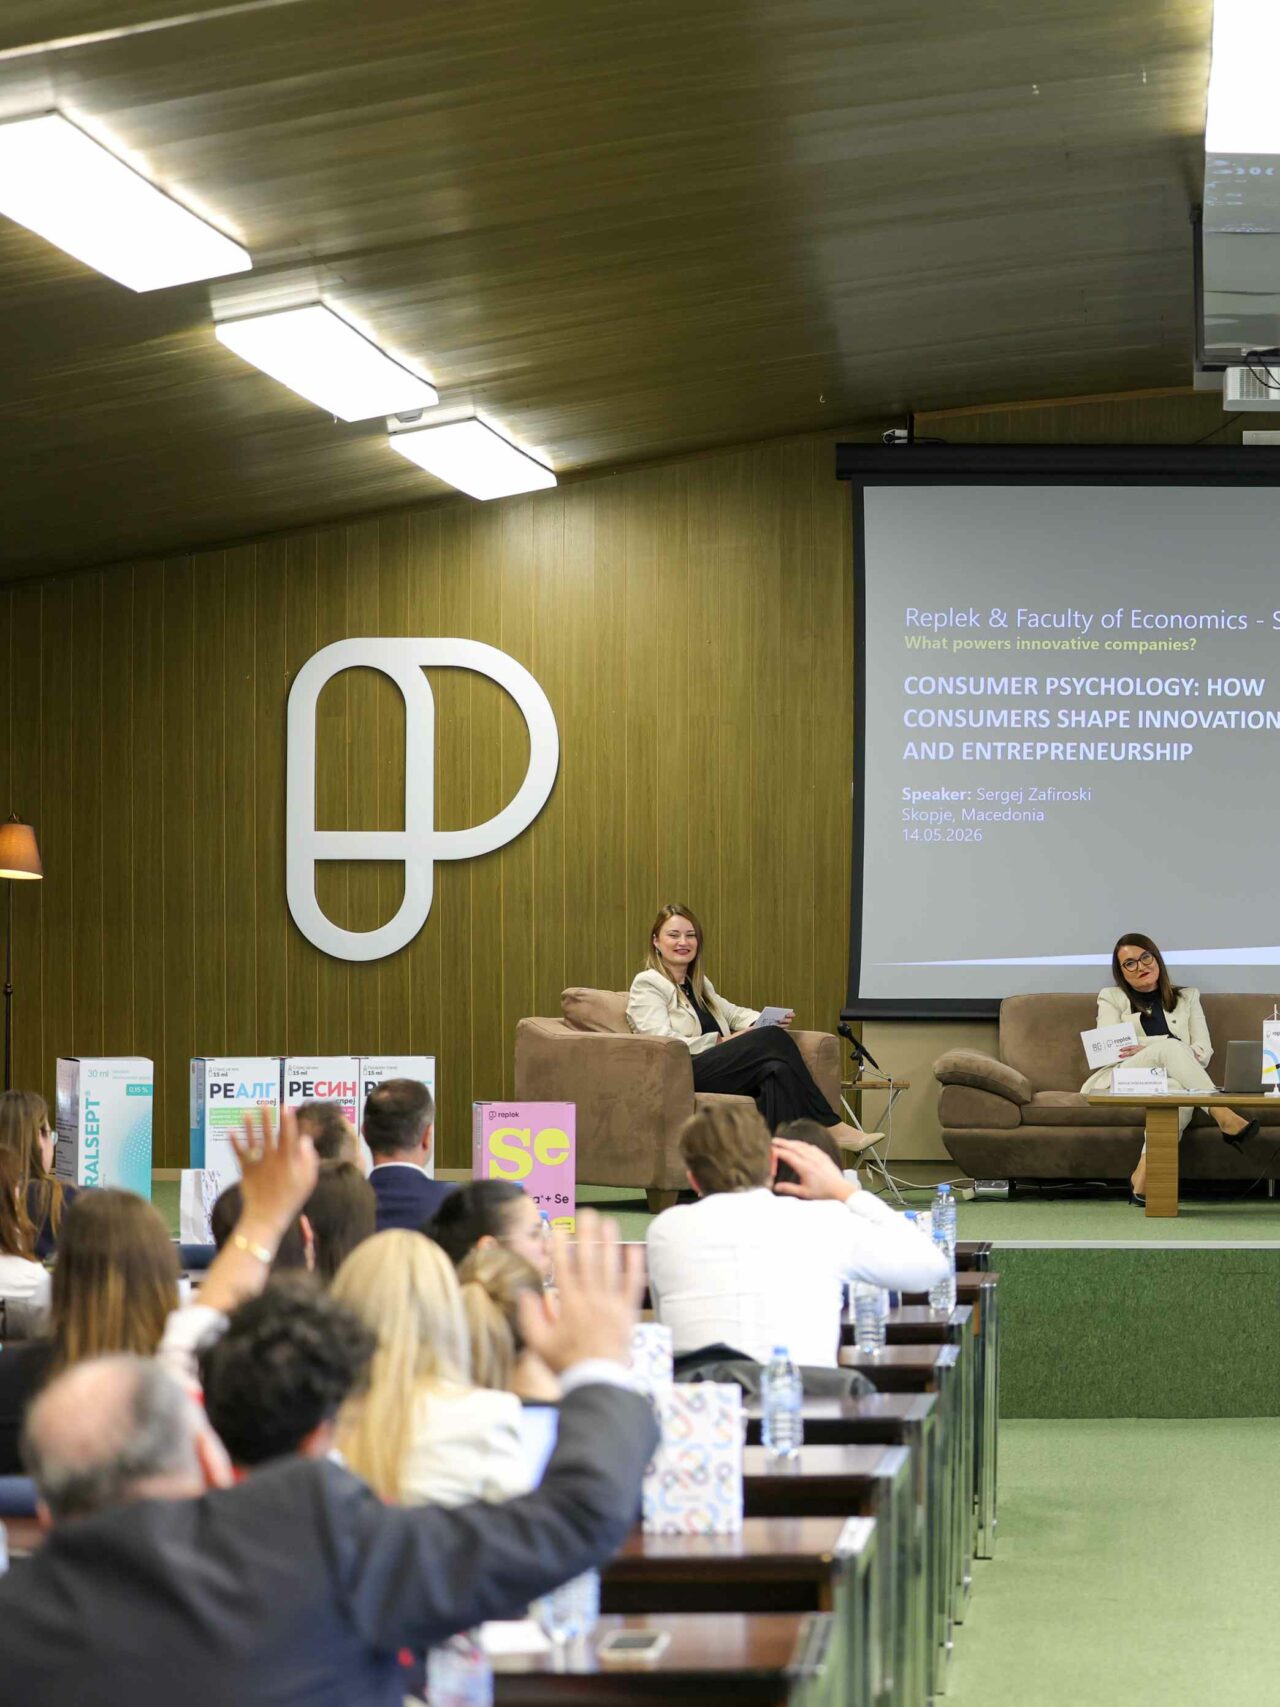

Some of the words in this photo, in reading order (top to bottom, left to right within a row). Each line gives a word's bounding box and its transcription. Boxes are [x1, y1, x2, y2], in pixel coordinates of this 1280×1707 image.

[906, 607, 981, 632] Replek
[988, 608, 1009, 628] &
[1016, 608, 1094, 634] Faculty
[1101, 608, 1124, 629] of
[1131, 609, 1248, 630] Economics
[904, 635, 948, 650] What
[953, 638, 1011, 653] powers
[1016, 637, 1100, 650] innovative
[1104, 637, 1197, 654] companies?
[903, 676, 1039, 696] CONSUMER
[1046, 677, 1199, 697] PSYCHOLOGY:
[1207, 678, 1266, 697] HOW
[903, 708, 1051, 728] CONSUMERS
[1056, 709, 1131, 728] SHAPE
[903, 741, 954, 760] AND
[962, 741, 1194, 761] ENTREPRENEURSHIP
[902, 787, 971, 804] Speaker:
[976, 787, 1024, 804] Sergej
[1028, 787, 1092, 801] Zafiroski
[902, 807, 956, 824] Skopje,
[961, 807, 1045, 822] Macedonia
[902, 828, 983, 842] 14.05.2026
[88, 1069, 98, 1078] 30
[99, 1069, 109, 1078] ml
[210, 1083, 276, 1099] РЕАЛГ
[289, 1081, 357, 1097] РЕСИН
[498, 1111, 520, 1119] replek
[488, 1127, 571, 1181] Se
[554, 1194, 570, 1204] Se
